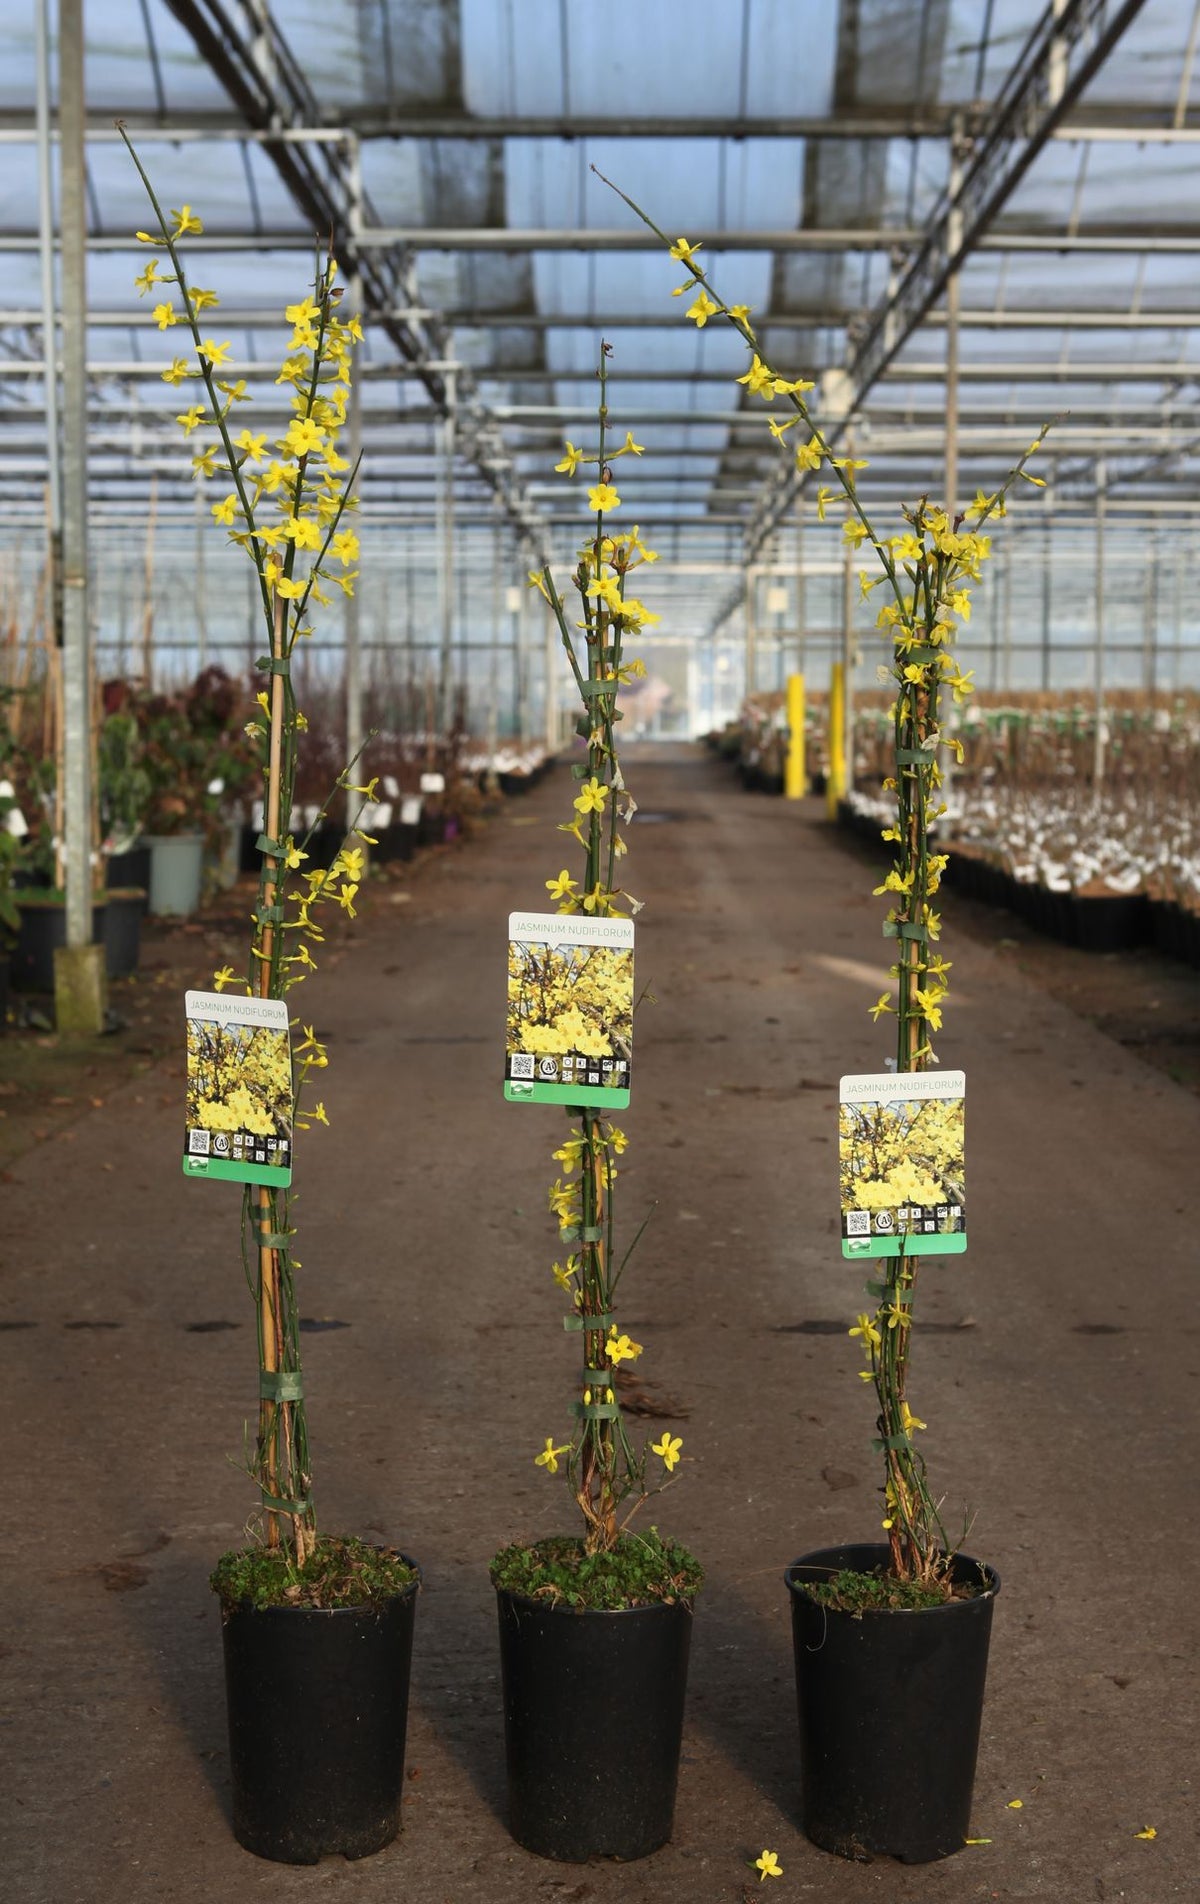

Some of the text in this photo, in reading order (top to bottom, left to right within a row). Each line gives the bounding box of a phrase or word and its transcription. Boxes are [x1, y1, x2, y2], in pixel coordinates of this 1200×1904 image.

[515, 922, 632, 938] JASMINUM NUDIFLORUM
[190, 1001, 286, 1019] JASMINUM NUDIFLORUM
[846, 1080, 963, 1094] JASMINUM NUDIFLORUM
